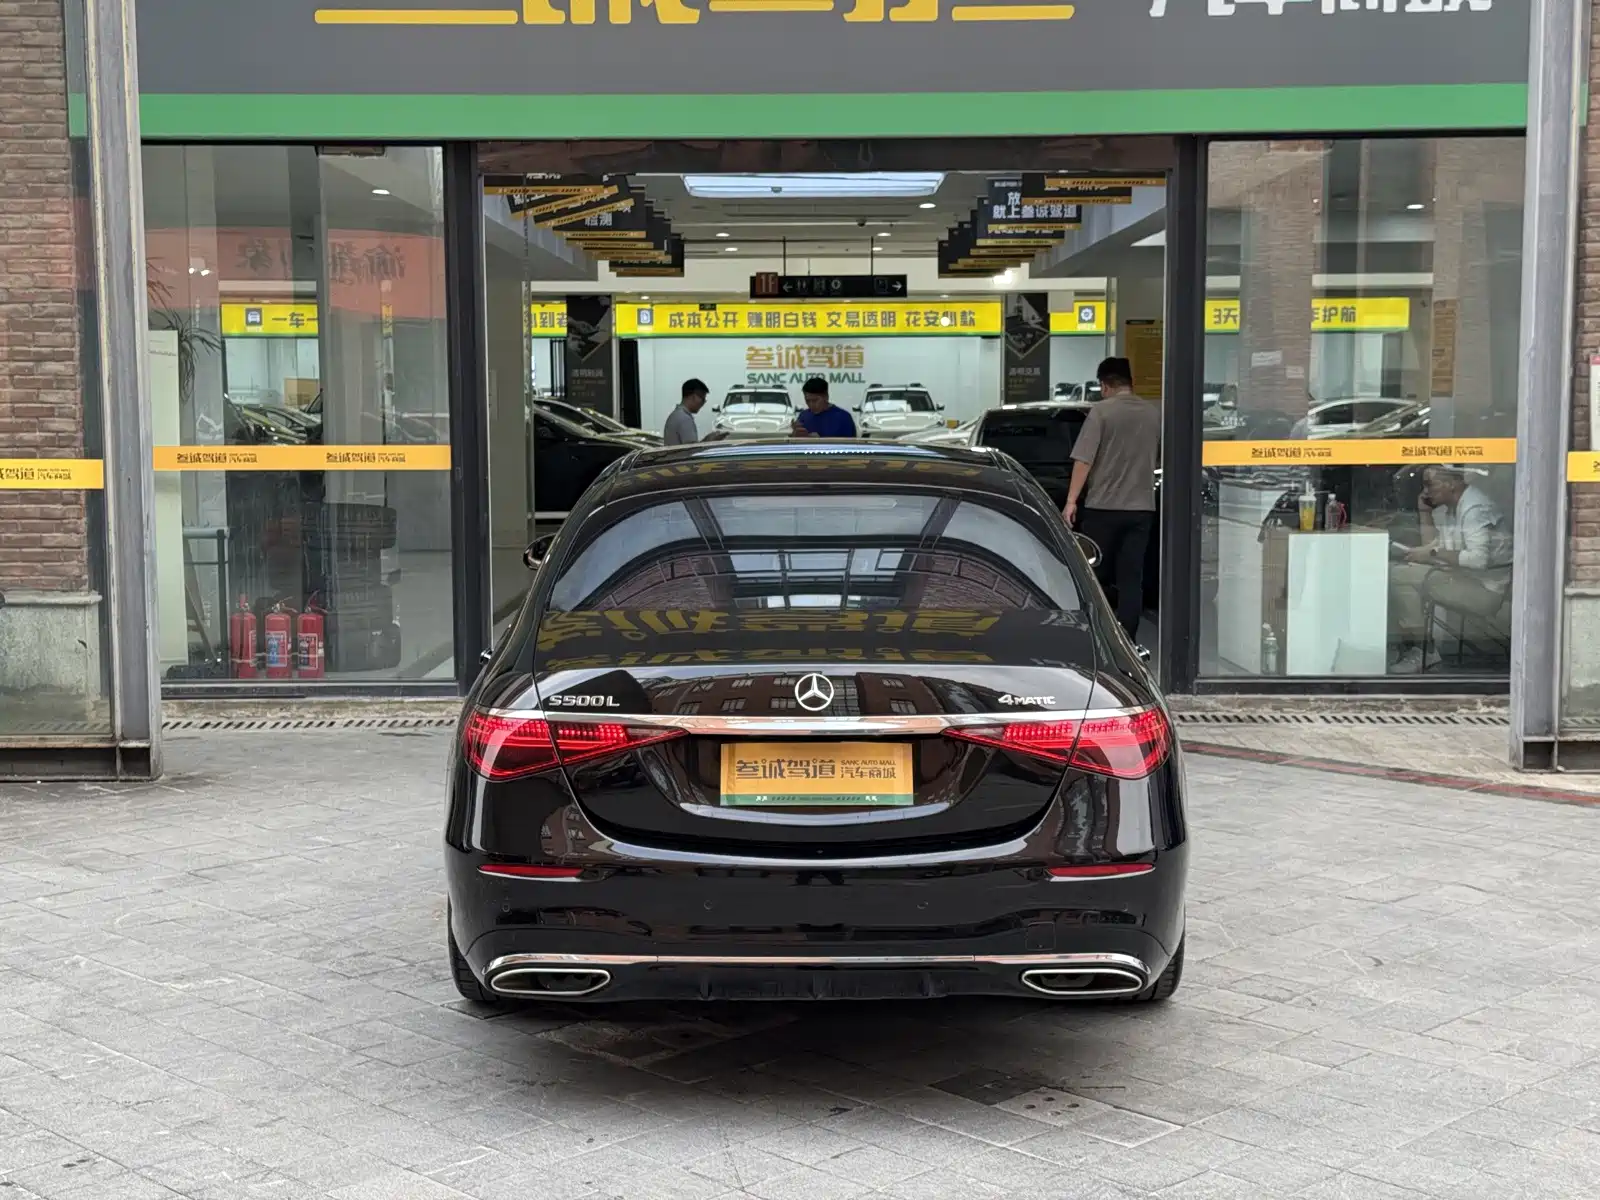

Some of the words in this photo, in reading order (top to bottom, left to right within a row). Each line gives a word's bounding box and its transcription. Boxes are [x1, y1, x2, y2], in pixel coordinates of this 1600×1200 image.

[668, 311, 739, 329] 成本公开
[747, 311, 817, 329] 赚明白钱
[826, 310, 897, 328] 交易透明
[745, 344, 865, 370] 叁诚驾道
[746, 372, 787, 384] SANC
[829, 372, 866, 384] MALL
[998, 694, 1056, 705] 4MATIC
[736, 758, 836, 780] 叁诚驾道
[840, 766, 897, 779] 汽车商城
